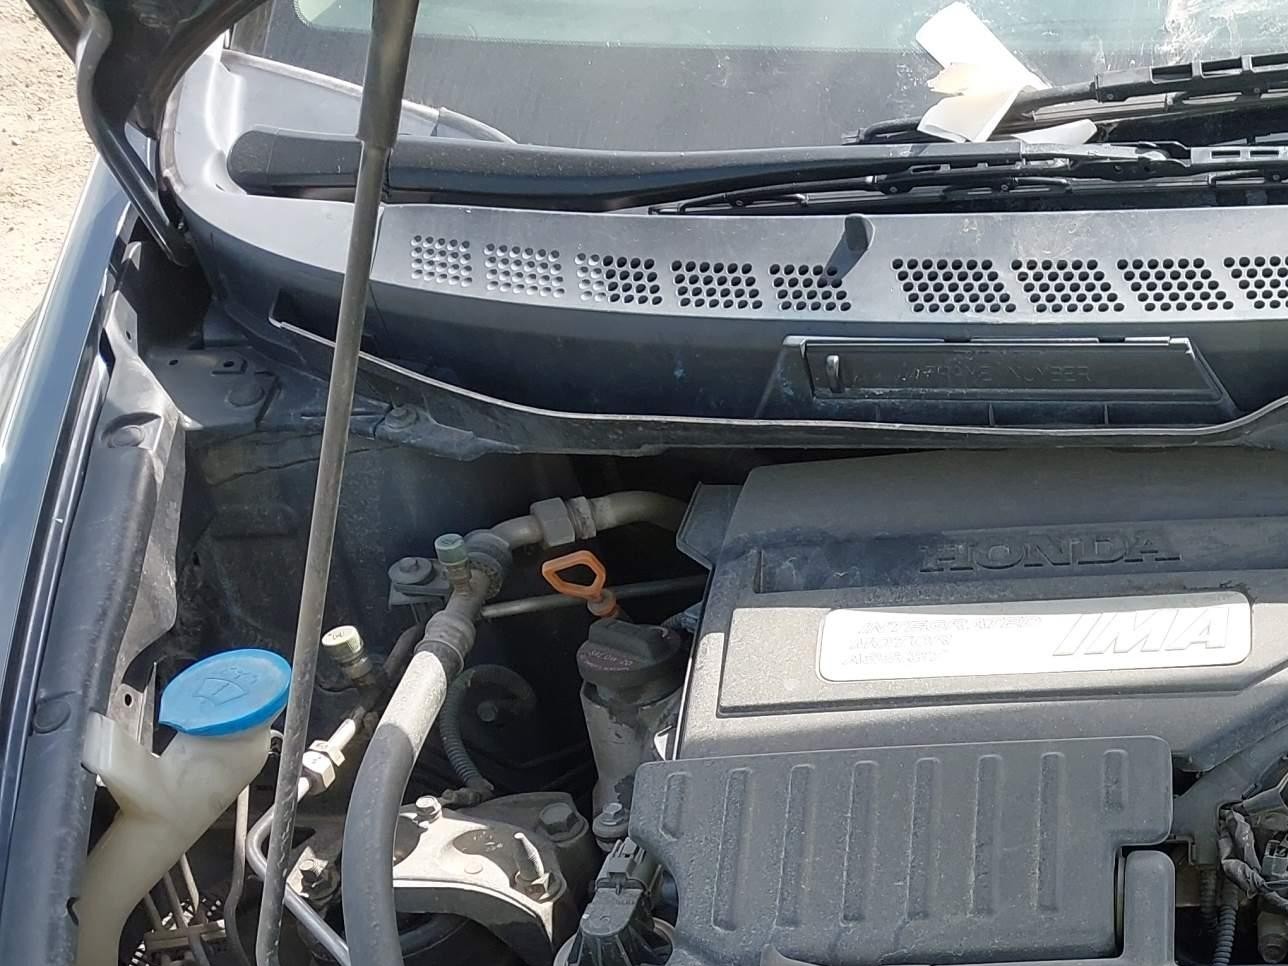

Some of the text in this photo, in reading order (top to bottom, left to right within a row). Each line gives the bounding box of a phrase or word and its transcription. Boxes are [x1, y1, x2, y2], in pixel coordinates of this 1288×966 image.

[1007, 364, 1092, 382] NUMBER
[918, 537, 1182, 573] HONDA
[1052, 607, 1230, 657] IMA
